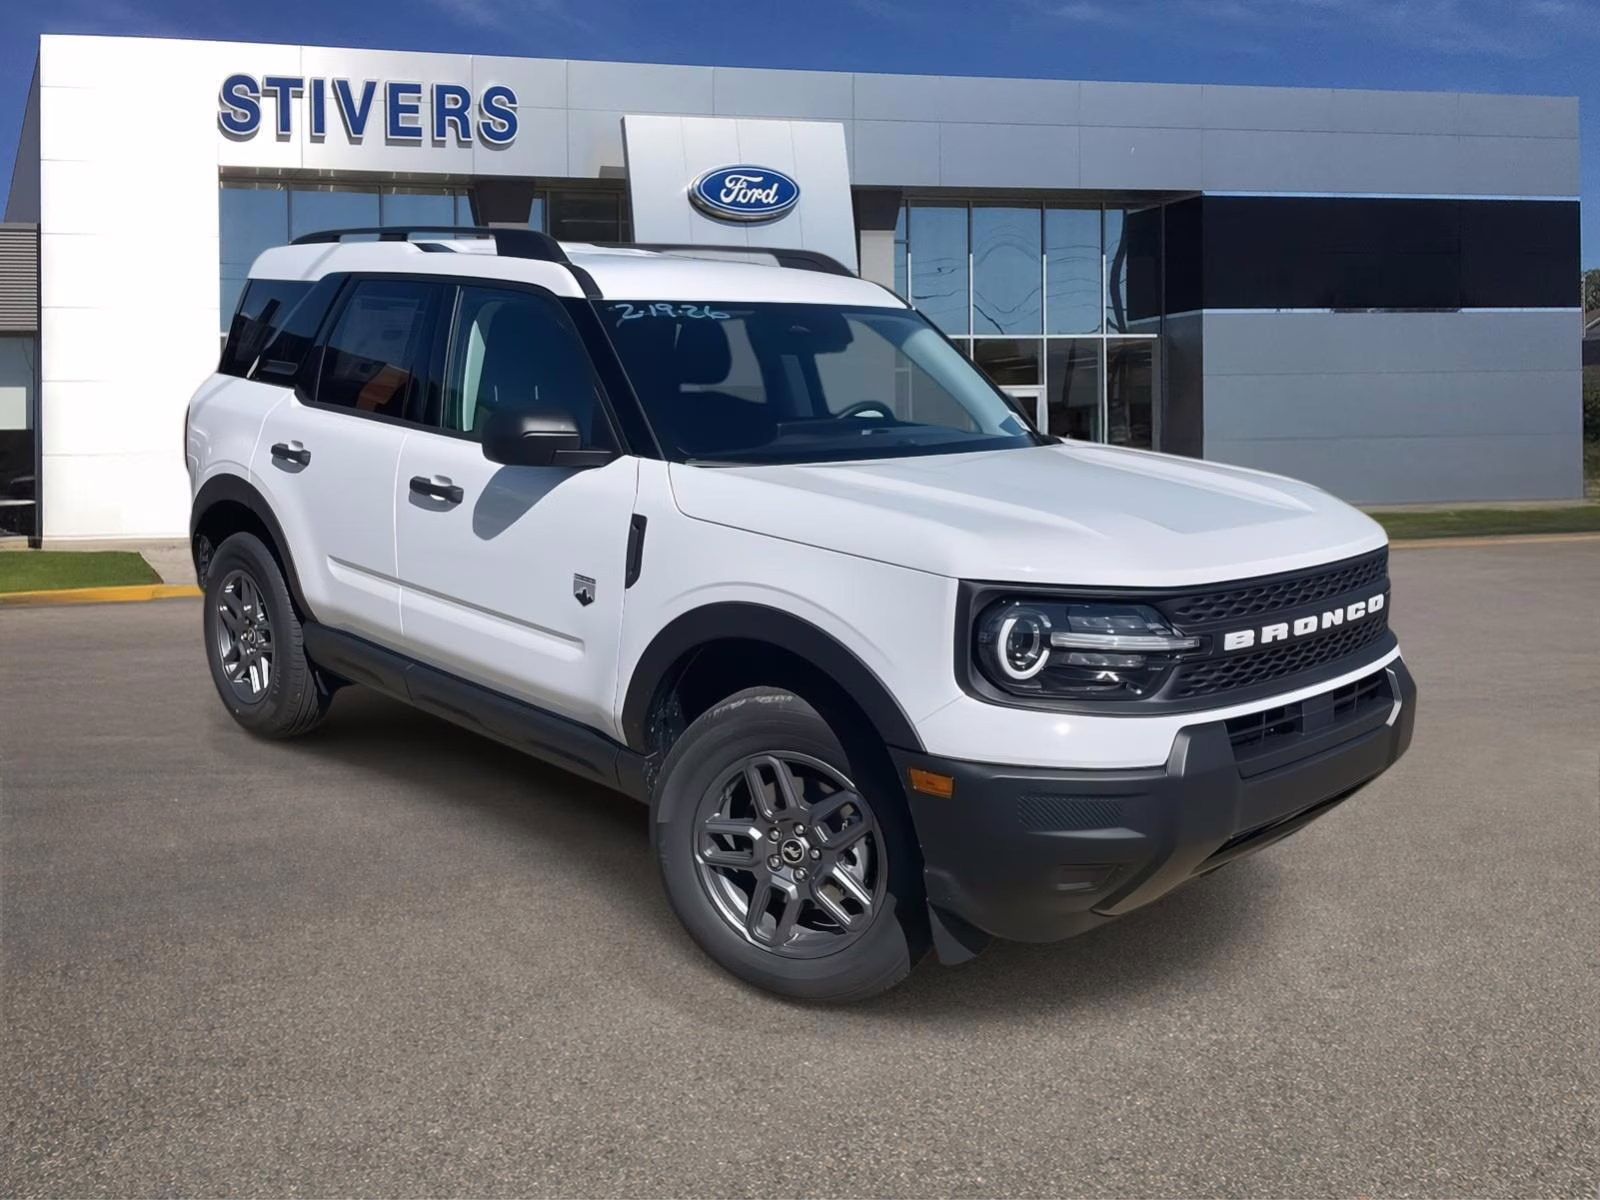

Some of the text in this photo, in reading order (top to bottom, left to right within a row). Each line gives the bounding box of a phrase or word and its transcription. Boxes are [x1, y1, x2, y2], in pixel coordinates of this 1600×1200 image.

[218, 73, 518, 145] STIVERS
[720, 174, 779, 204] Ford
[1223, 593, 1384, 651] BRONCO
